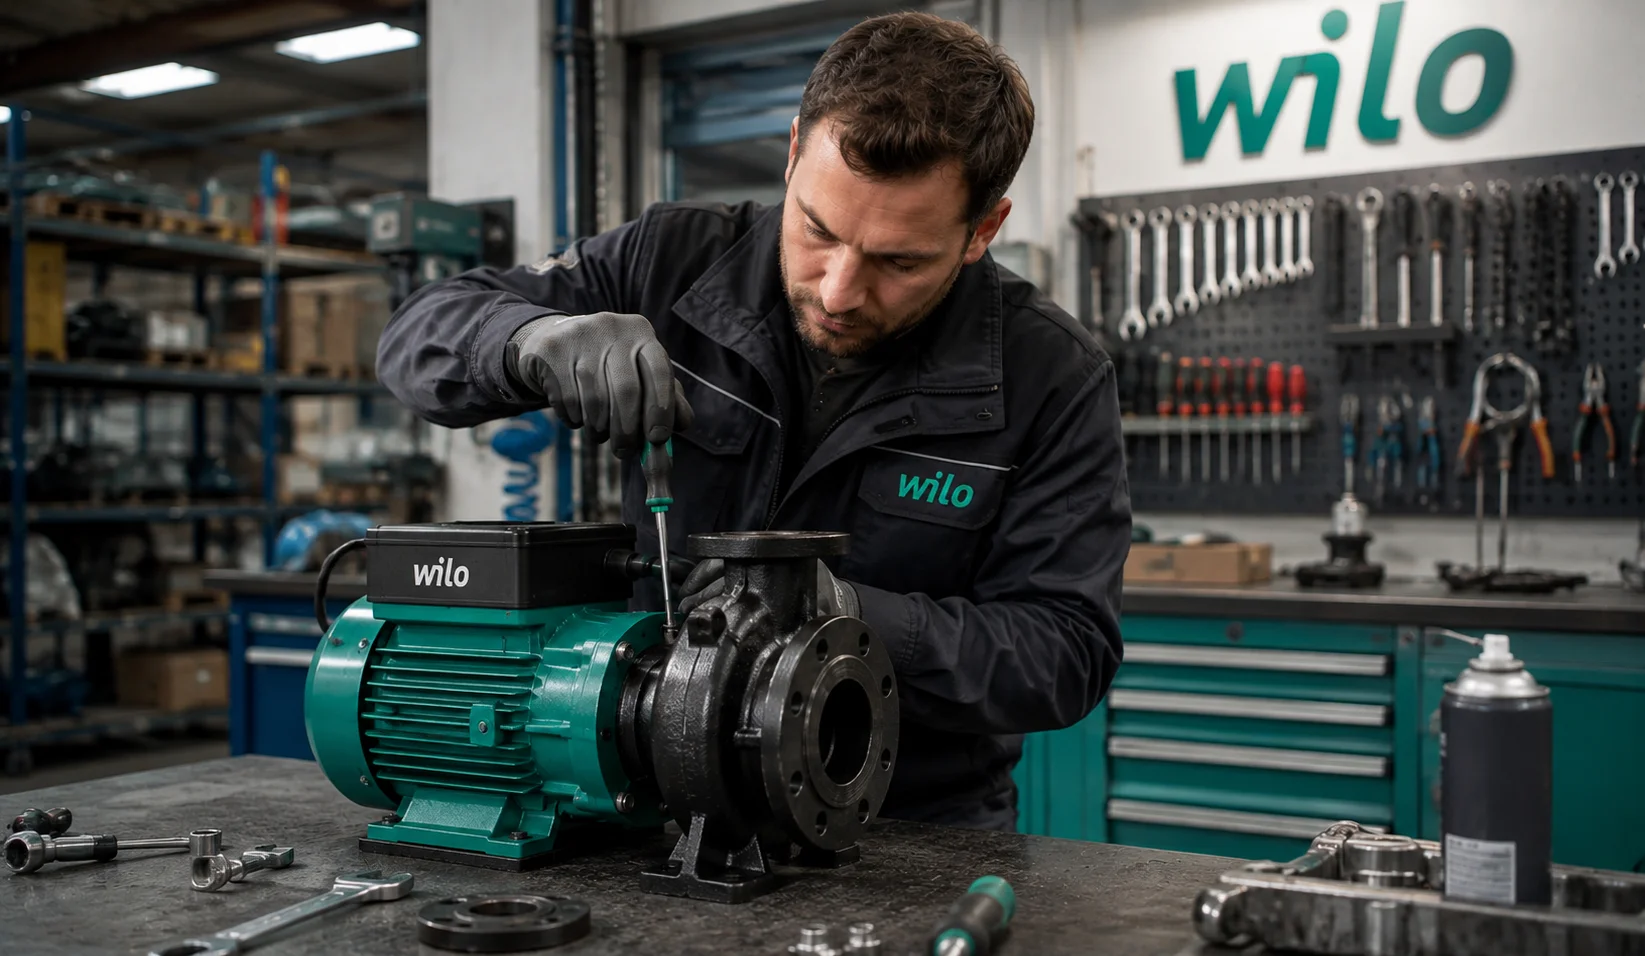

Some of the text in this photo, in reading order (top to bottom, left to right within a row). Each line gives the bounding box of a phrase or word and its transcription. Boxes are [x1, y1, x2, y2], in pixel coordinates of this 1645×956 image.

[1174, 1, 1514, 161] wilo
[898, 471, 974, 508] wilo
[413, 556, 470, 588] wilo
